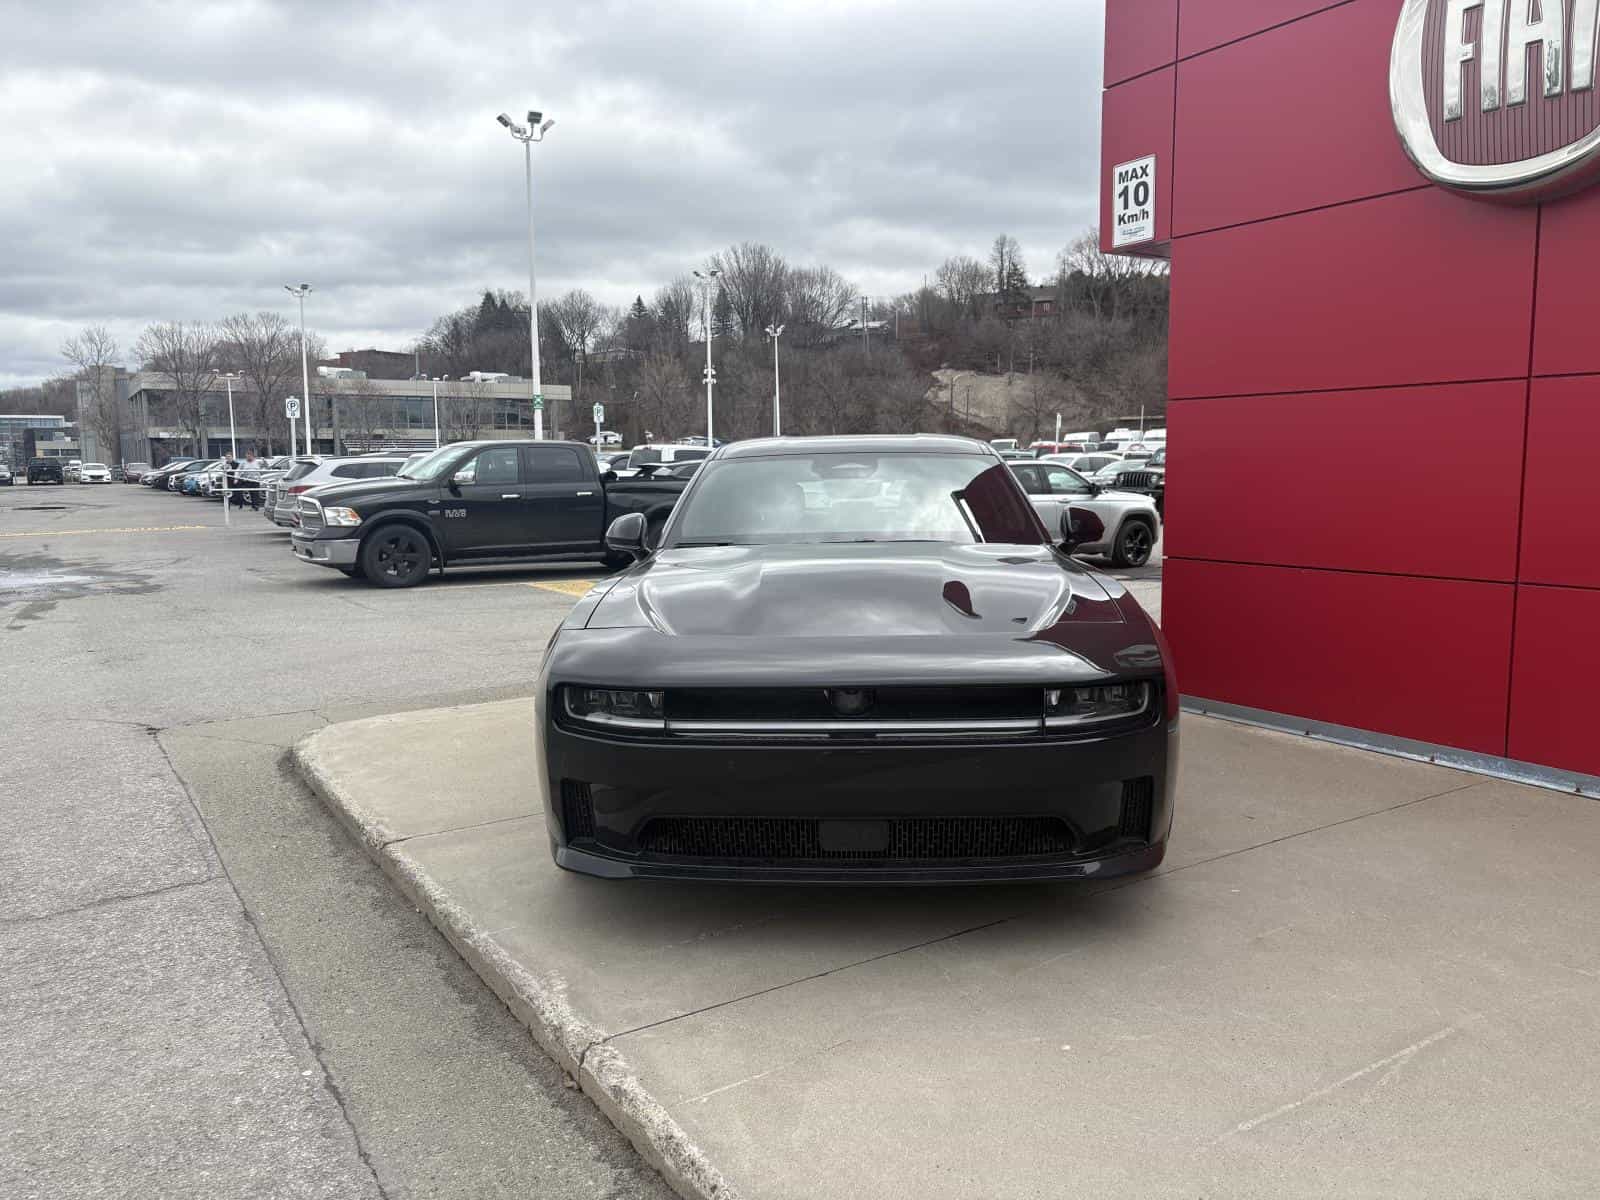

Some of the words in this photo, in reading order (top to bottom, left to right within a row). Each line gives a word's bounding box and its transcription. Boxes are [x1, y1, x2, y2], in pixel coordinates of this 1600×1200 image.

[1118, 164, 1149, 184] MAX
[1118, 180, 1150, 211] 10
[1118, 207, 1150, 226] Km/h
